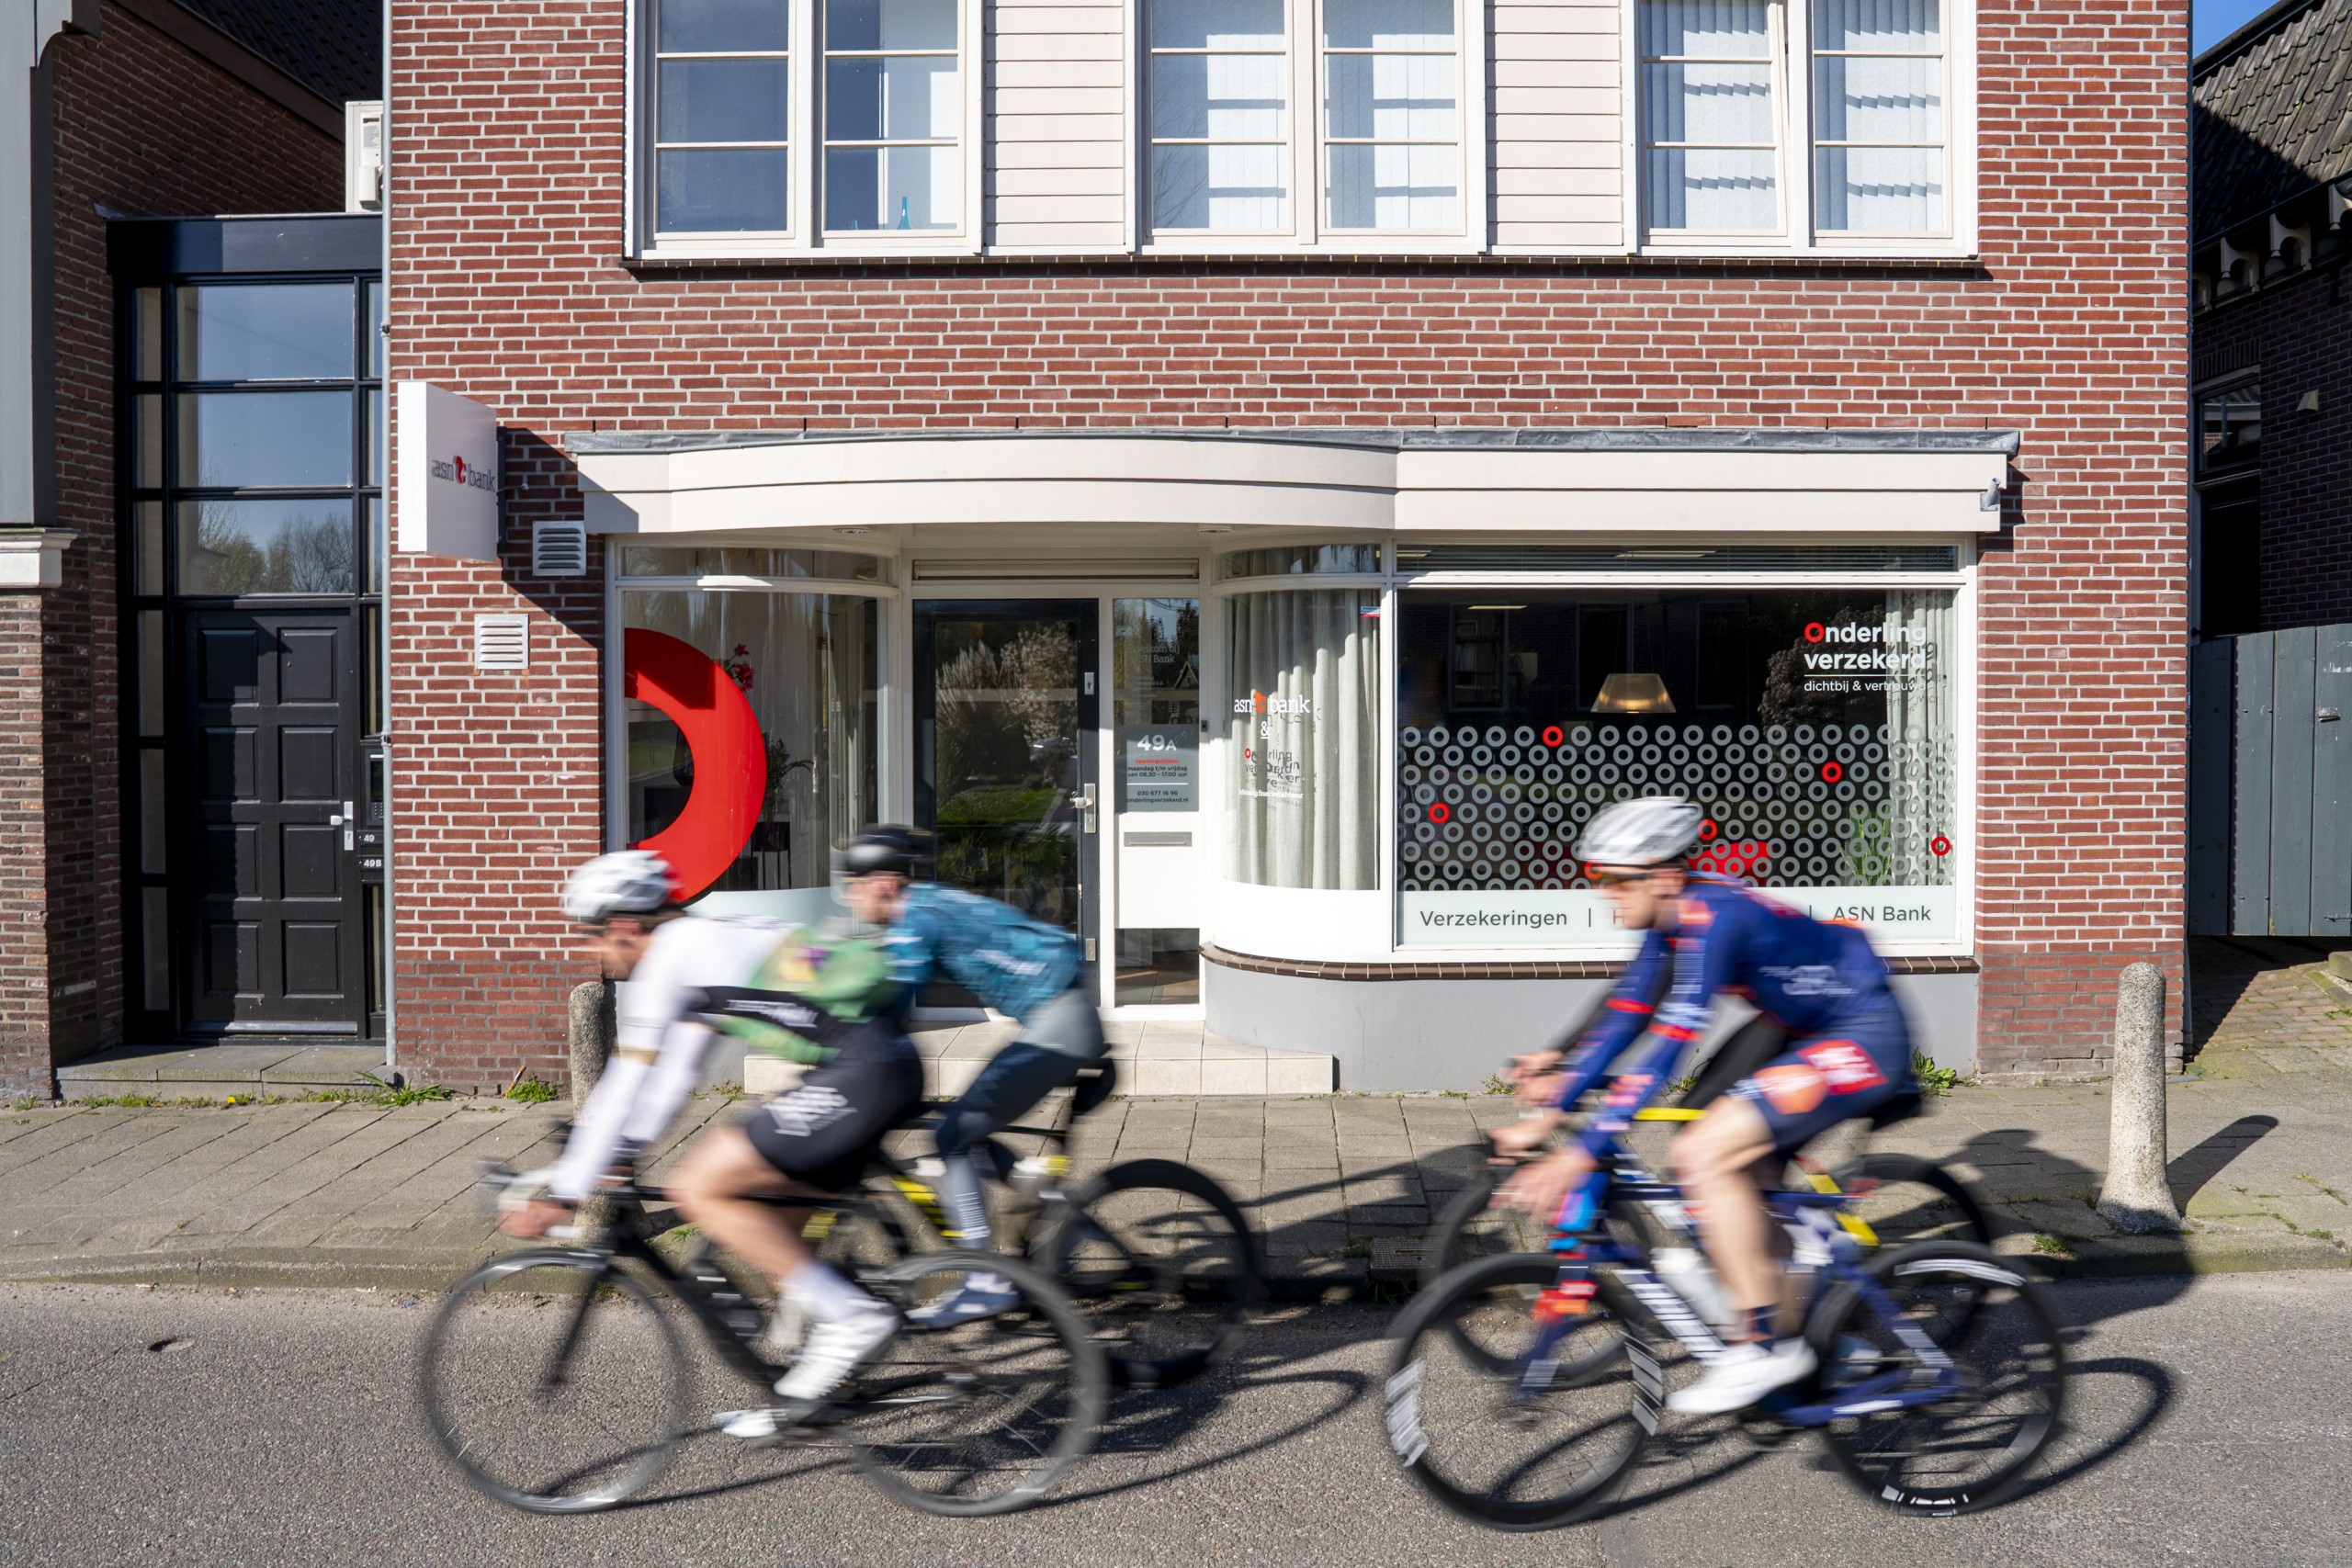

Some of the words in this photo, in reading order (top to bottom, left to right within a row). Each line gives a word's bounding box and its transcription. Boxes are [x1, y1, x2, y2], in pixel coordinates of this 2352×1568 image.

[432, 459, 455, 481] asn
[467, 463, 496, 492] bank
[1804, 622, 1927, 646] Onderling
[1153, 654, 1175, 663] Bank
[1804, 649, 1927, 670] verzekerd
[1804, 681, 1849, 694] dichtbij
[1852, 681, 1861, 691] &
[1234, 698, 1252, 713] asn
[1269, 694, 1311, 713] bank
[1136, 734, 1177, 751] 49A
[363, 834, 375, 842] 49
[363, 859, 382, 867] 49B
[1419, 909, 1568, 929] Verzekeringen
[1833, 906, 1875, 921] ASN
[1883, 905, 1931, 921] Bank
